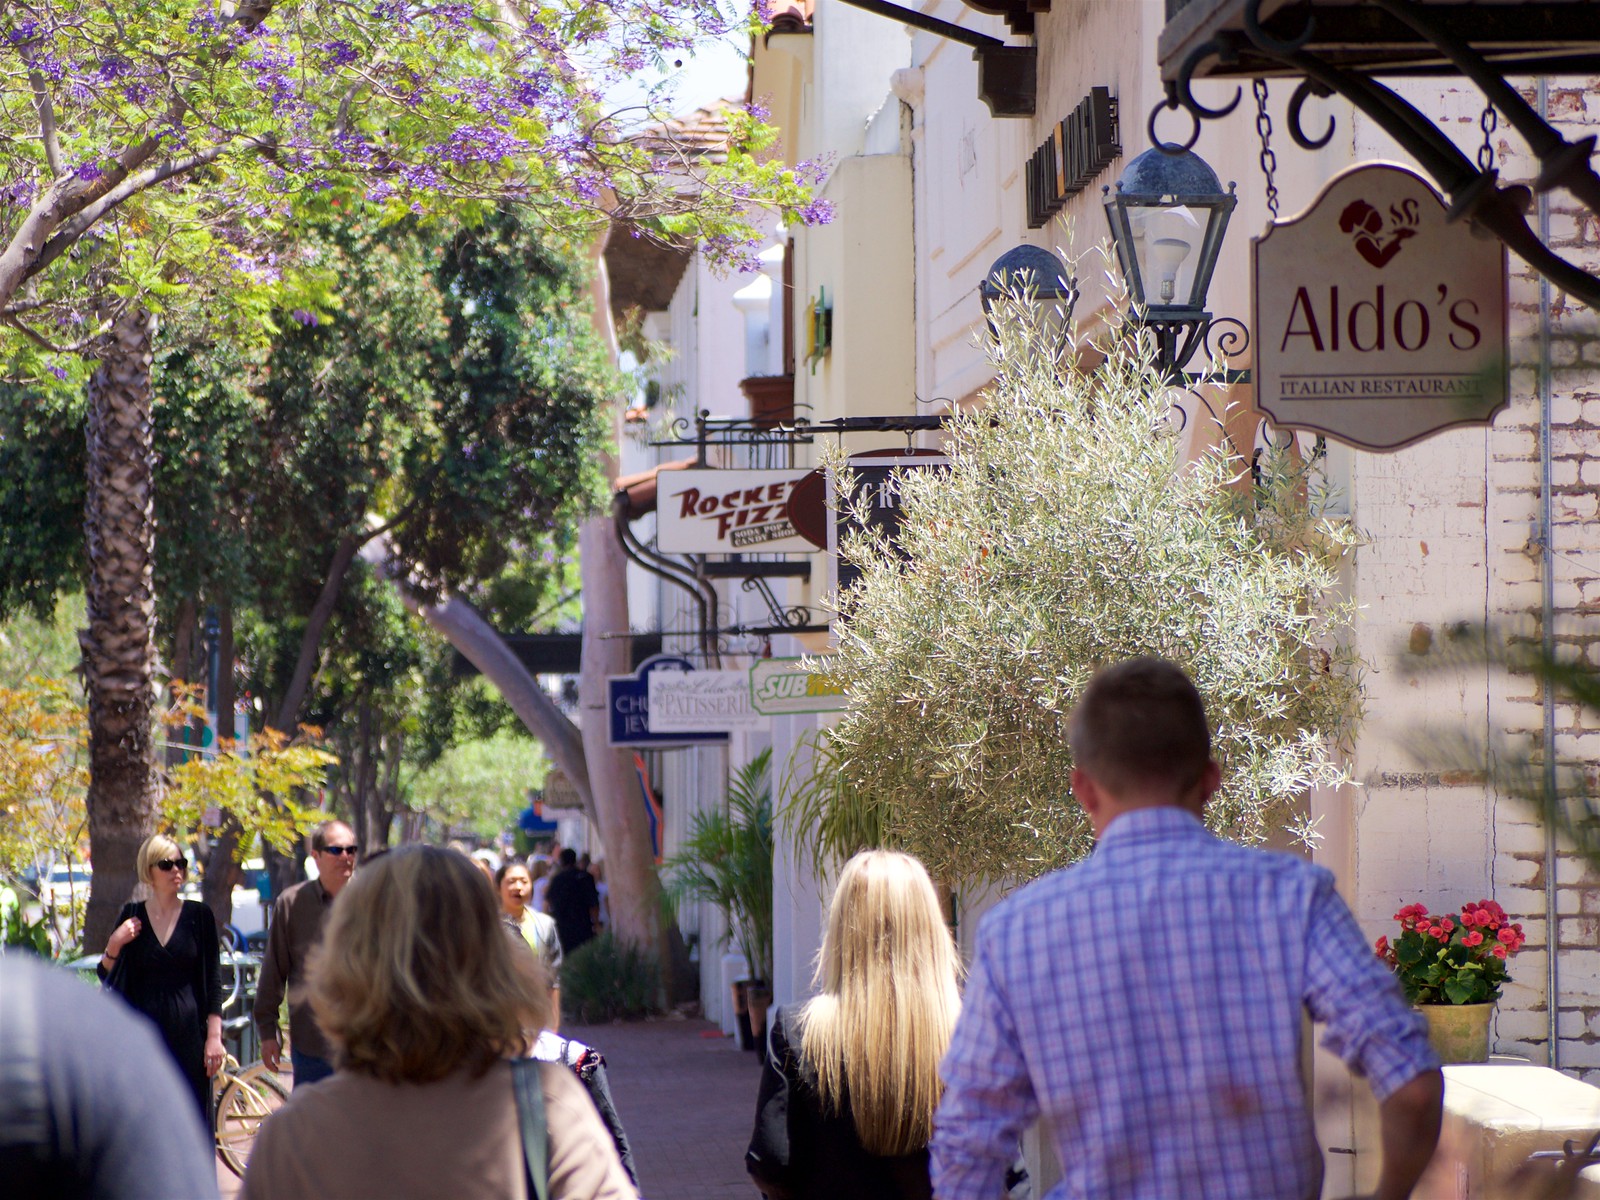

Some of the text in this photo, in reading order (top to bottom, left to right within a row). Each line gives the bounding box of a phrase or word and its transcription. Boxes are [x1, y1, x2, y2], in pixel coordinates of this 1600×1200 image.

[1280, 283, 1481, 352] Aldo's
[1280, 379, 1355, 395] ITALIAN
[734, 528, 760, 538] SODA
[763, 523, 783, 533] POP
[734, 533, 767, 546] CANDY
